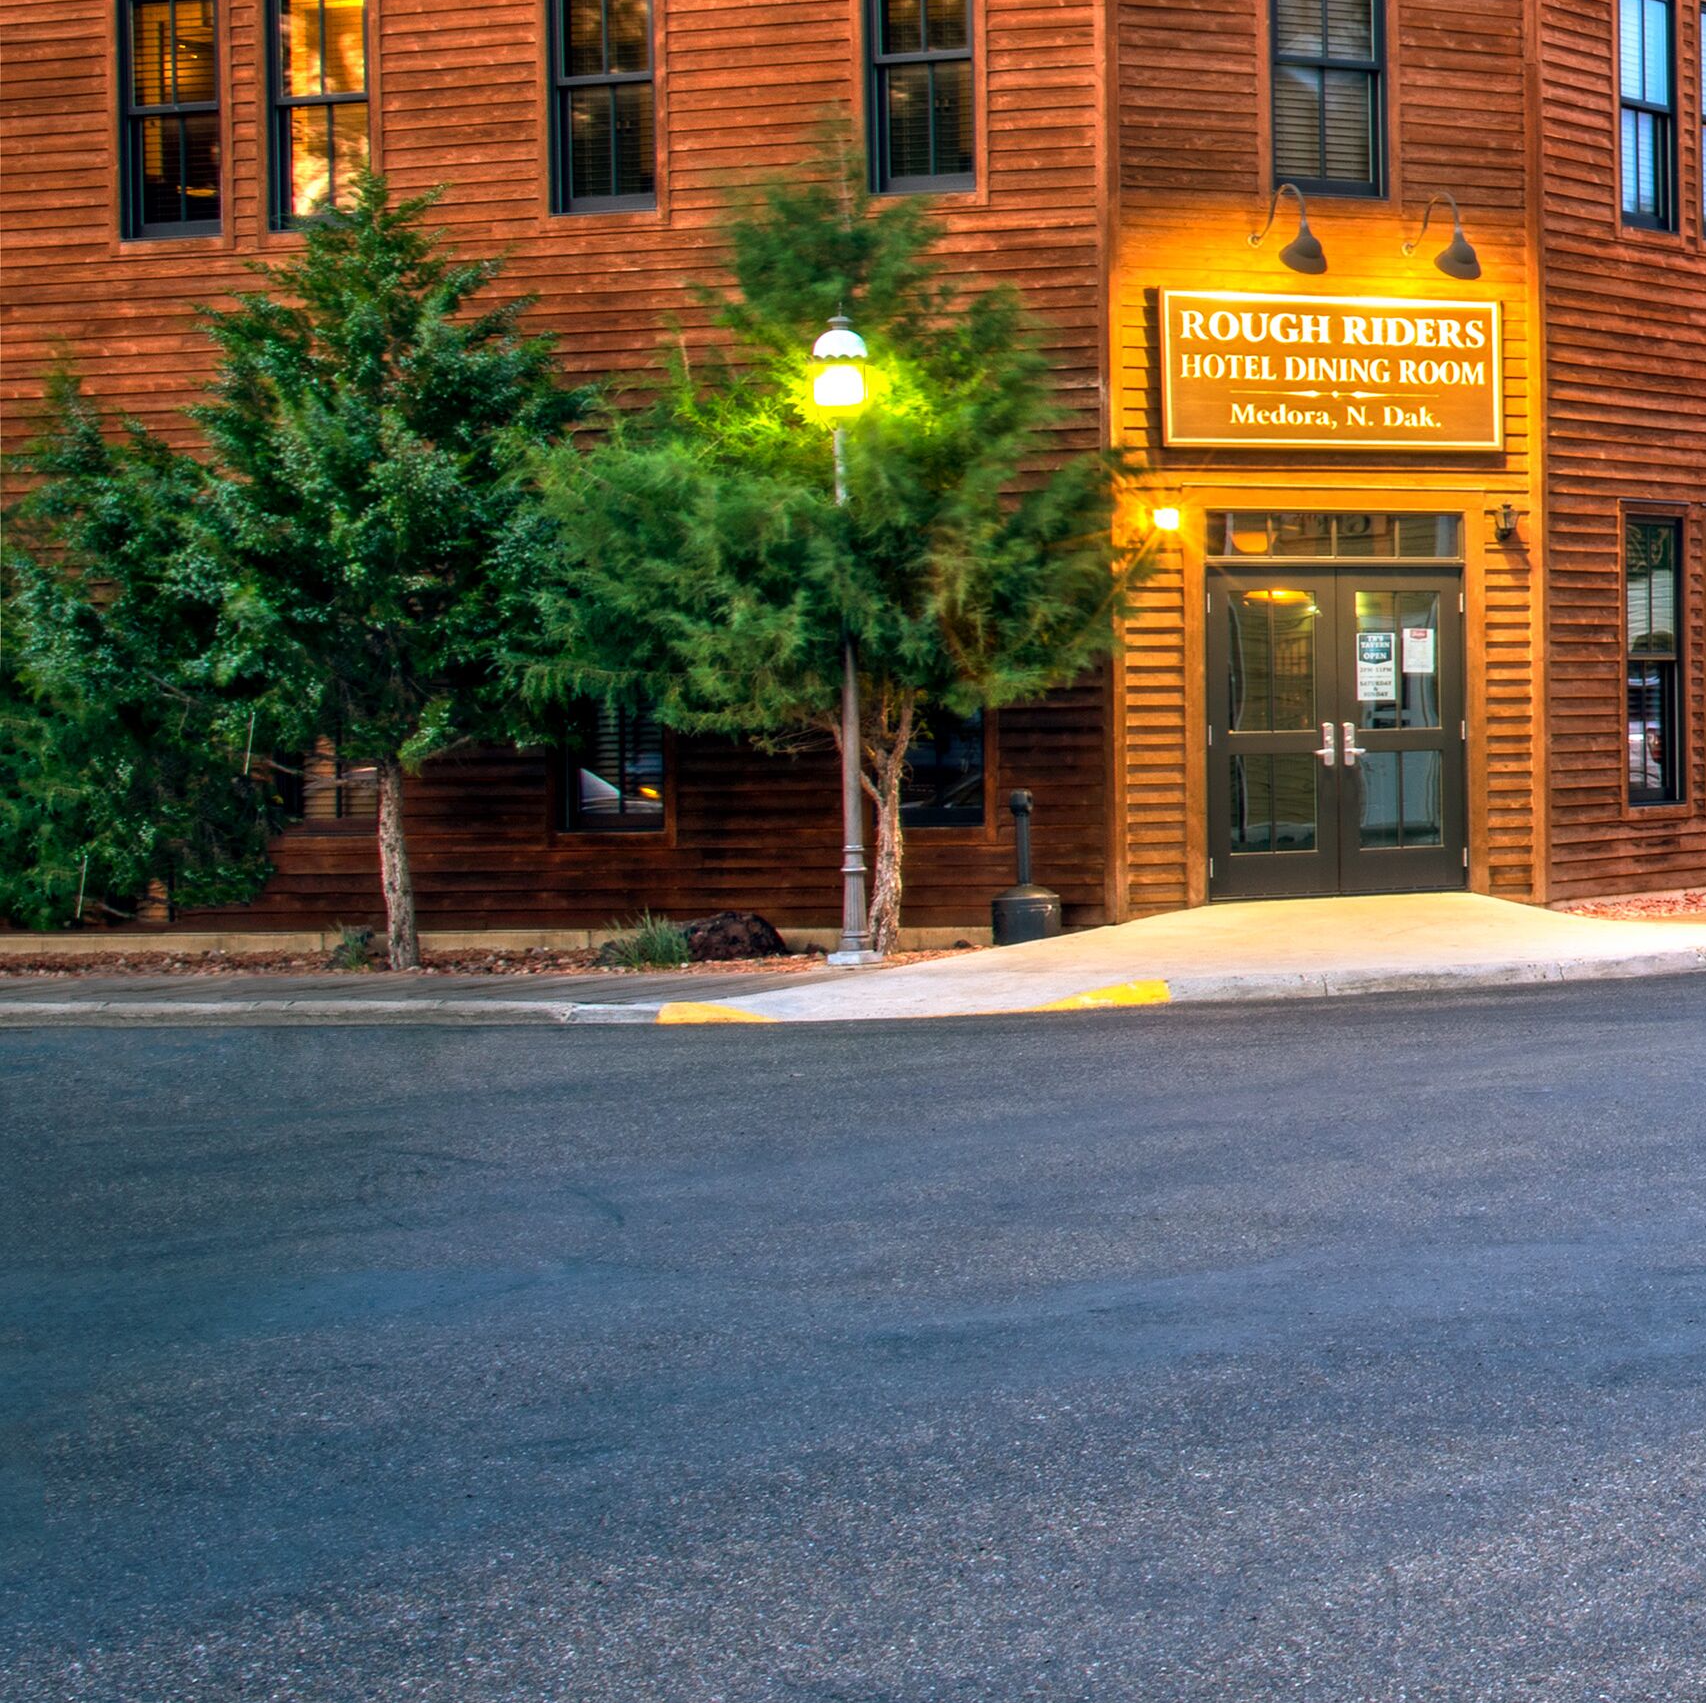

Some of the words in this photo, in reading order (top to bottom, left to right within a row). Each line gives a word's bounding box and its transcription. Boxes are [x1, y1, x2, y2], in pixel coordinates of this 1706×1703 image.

[1179, 309, 1331, 345] ROUGH
[1341, 315, 1486, 349] RIDERS
[1180, 354, 1277, 381] HOTEL
[1284, 356, 1391, 385] DINING
[1399, 360, 1486, 386] ROOM
[1230, 403, 1338, 431] Medora,
[1346, 407, 1374, 427] N.
[1383, 406, 1442, 429] Dak.
